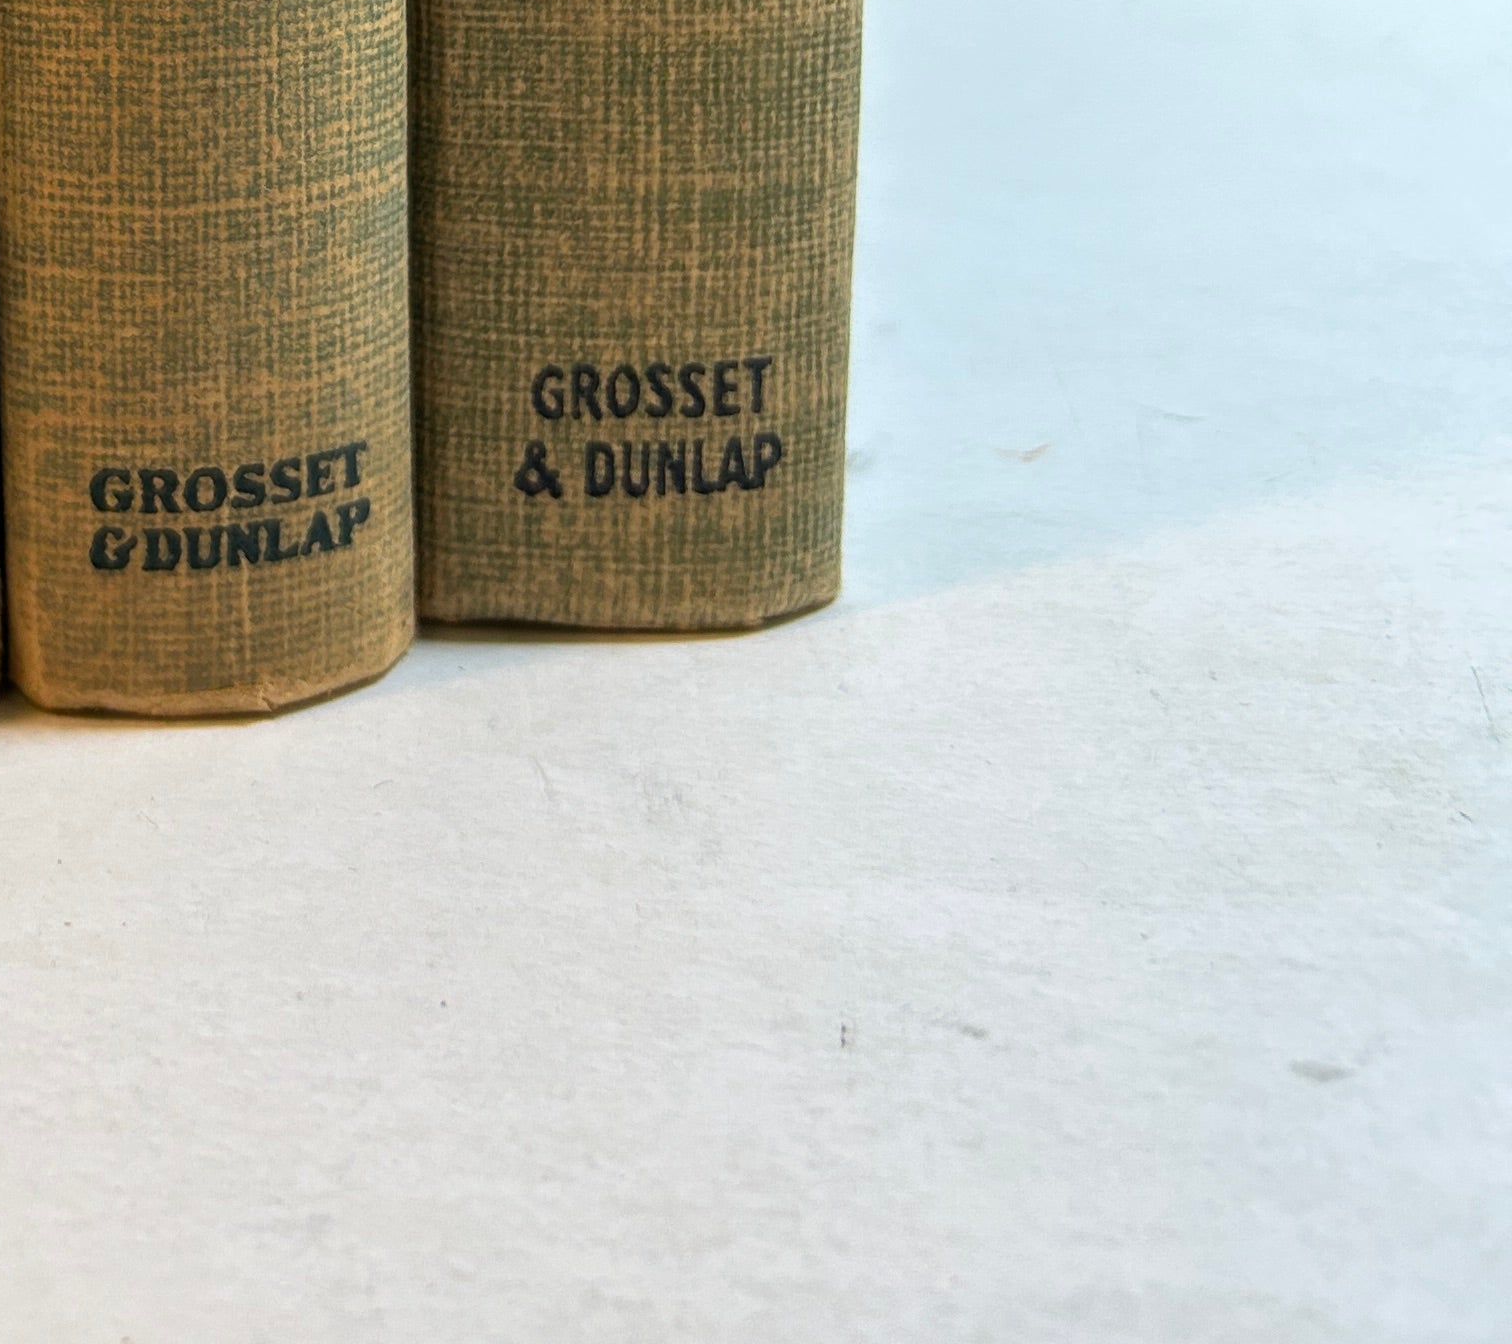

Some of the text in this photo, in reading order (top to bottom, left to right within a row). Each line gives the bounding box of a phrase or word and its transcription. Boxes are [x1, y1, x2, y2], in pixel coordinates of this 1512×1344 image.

[531, 356, 772, 420] GROSSET
[90, 439, 367, 513] GROSSET
[514, 432, 782, 499] & DUNLAP
